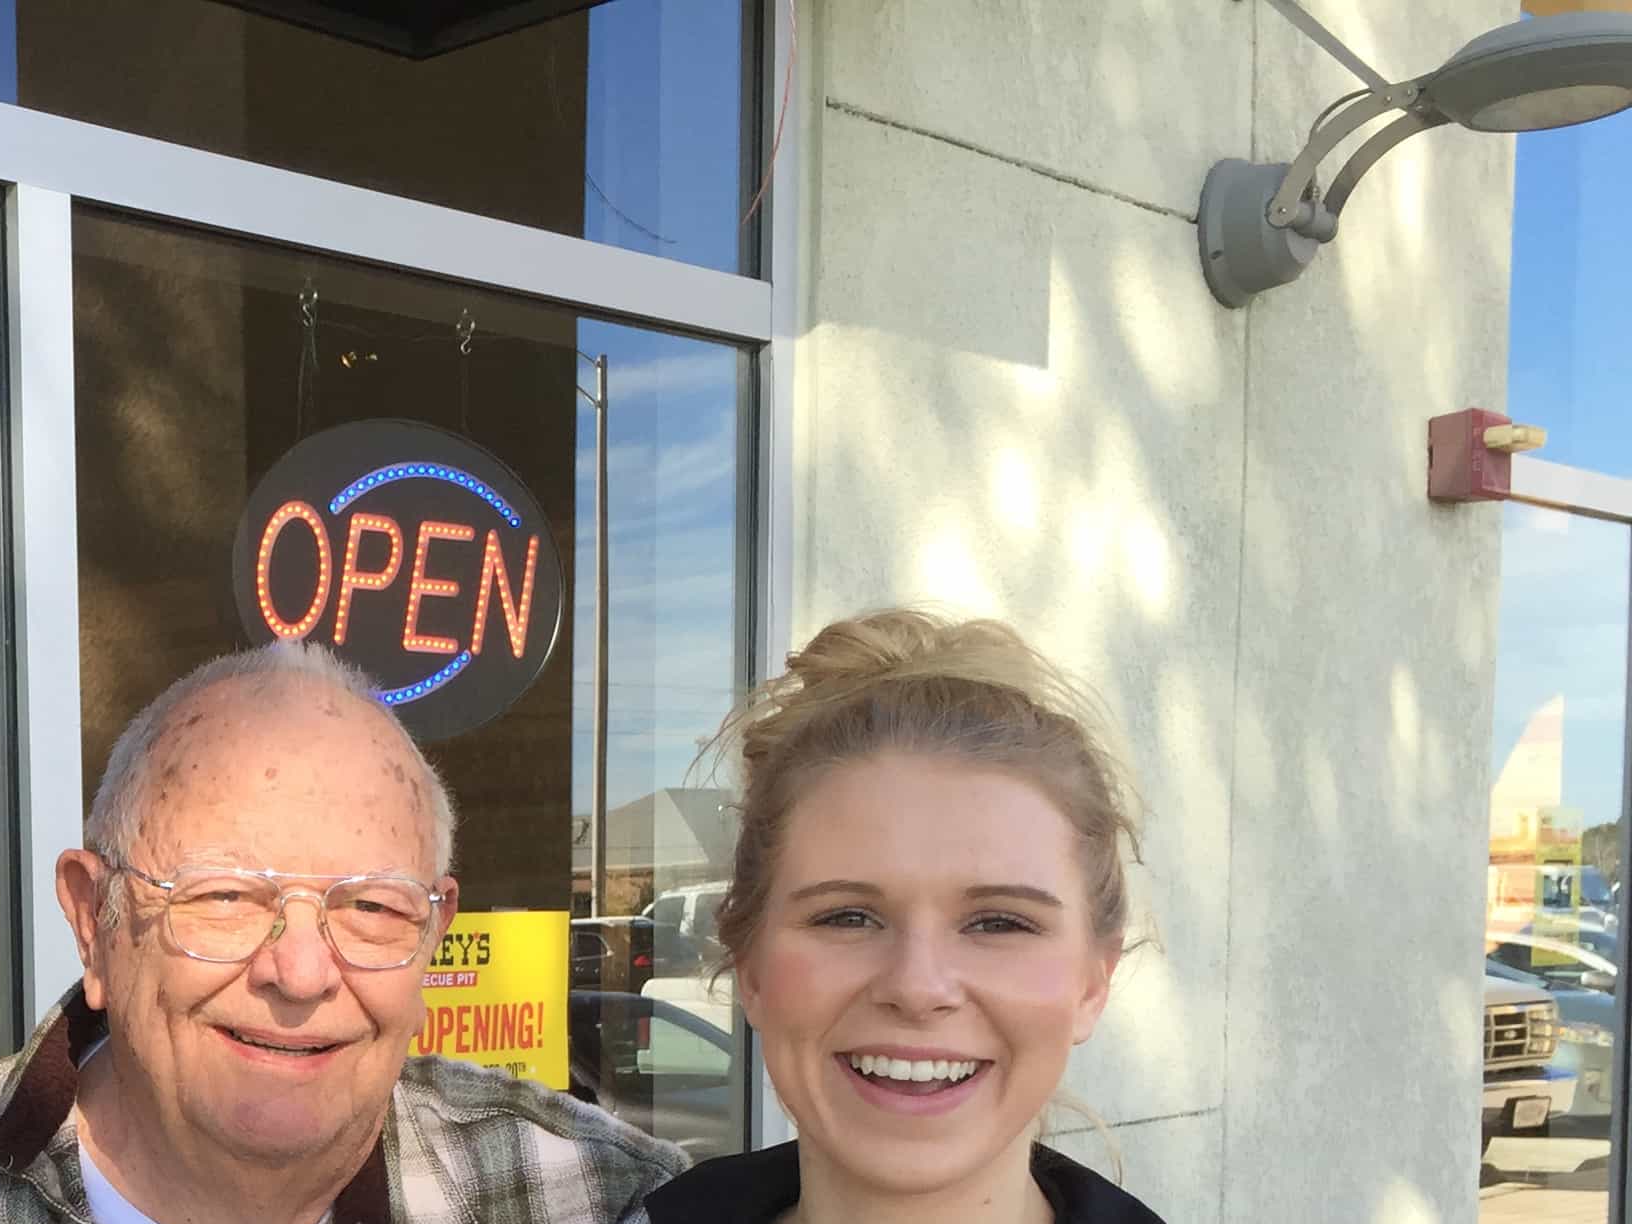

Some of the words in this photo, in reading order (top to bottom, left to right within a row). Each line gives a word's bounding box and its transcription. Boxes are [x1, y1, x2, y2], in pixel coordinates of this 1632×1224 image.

[257, 500, 539, 658] OPEN
[457, 972, 476, 985] PIT
[418, 1001, 544, 1055] OPENING!
